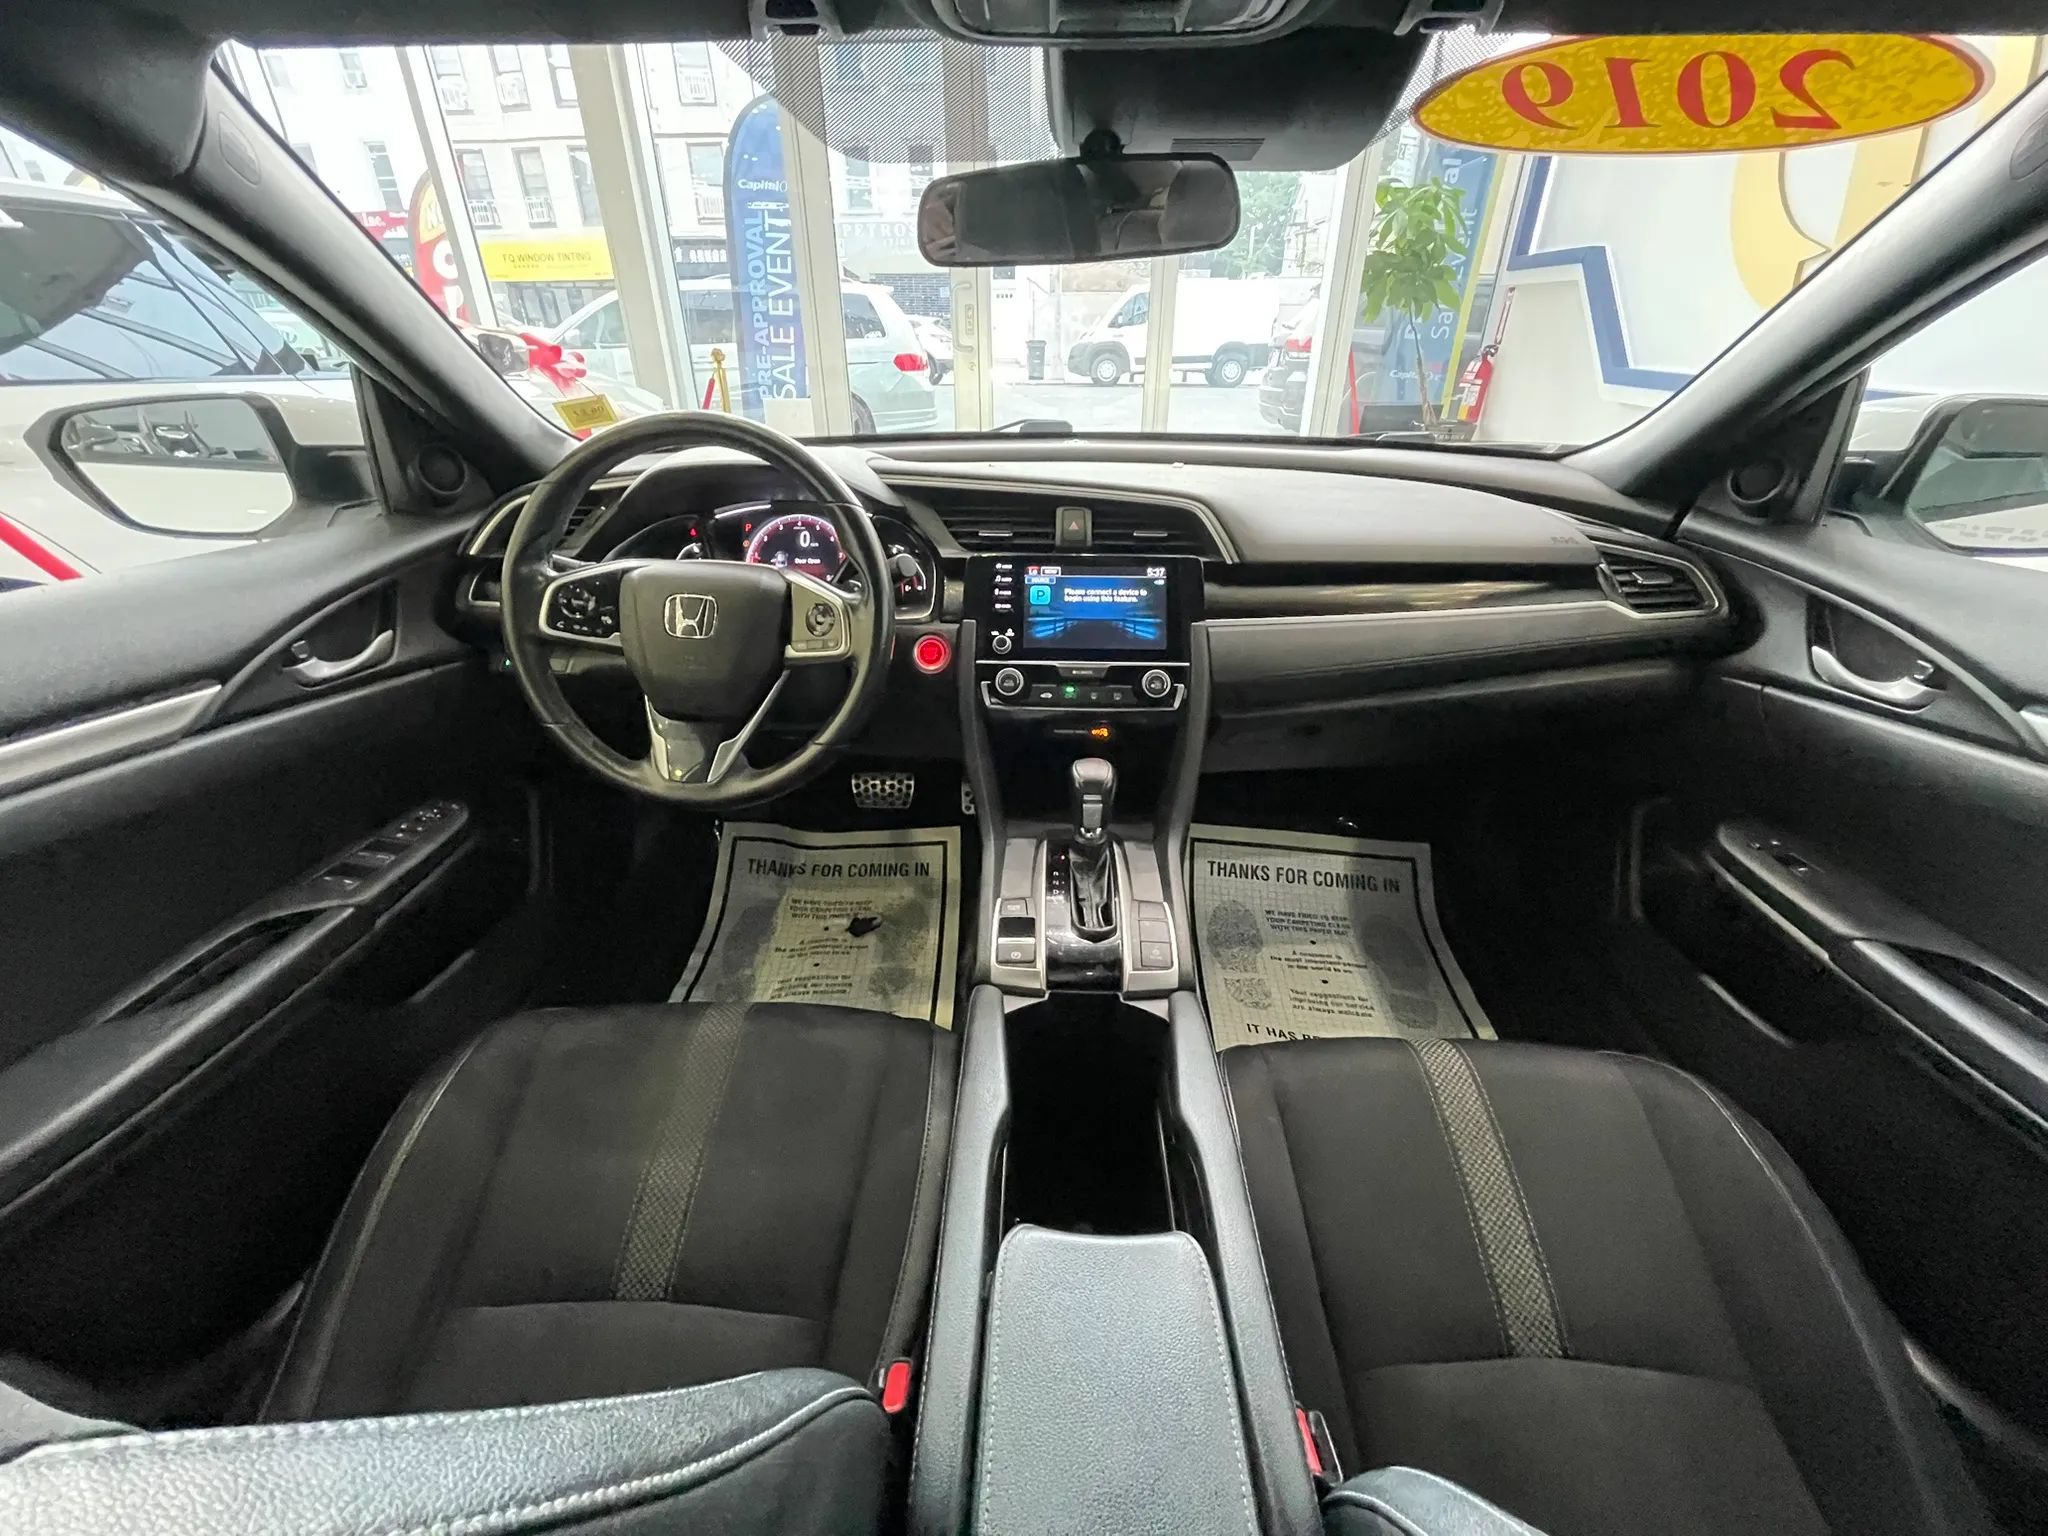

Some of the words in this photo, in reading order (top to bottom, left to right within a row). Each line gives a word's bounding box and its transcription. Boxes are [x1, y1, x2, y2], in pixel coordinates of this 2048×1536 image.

[516, 252, 554, 263] WINDOW
[764, 210, 794, 316] EVENT
[744, 211, 773, 399] PRE-APPROVAL
[769, 326, 797, 400] SALE
[799, 530, 811, 547] 0
[1064, 588, 1086, 596] Please
[1118, 588, 1139, 596] device
[748, 858, 806, 878] THANKS
[811, 863, 842, 878] FOR
[848, 862, 909, 878] COMING
[914, 862, 930, 877] IN
[1207, 860, 1270, 881] THANKS
[1276, 866, 1308, 885] FOR
[1313, 870, 1379, 892] COMING
[1383, 878, 1400, 893] IN
[1247, 1022, 1261, 1035] IT
[1266, 1026, 1298, 1041] HAS
